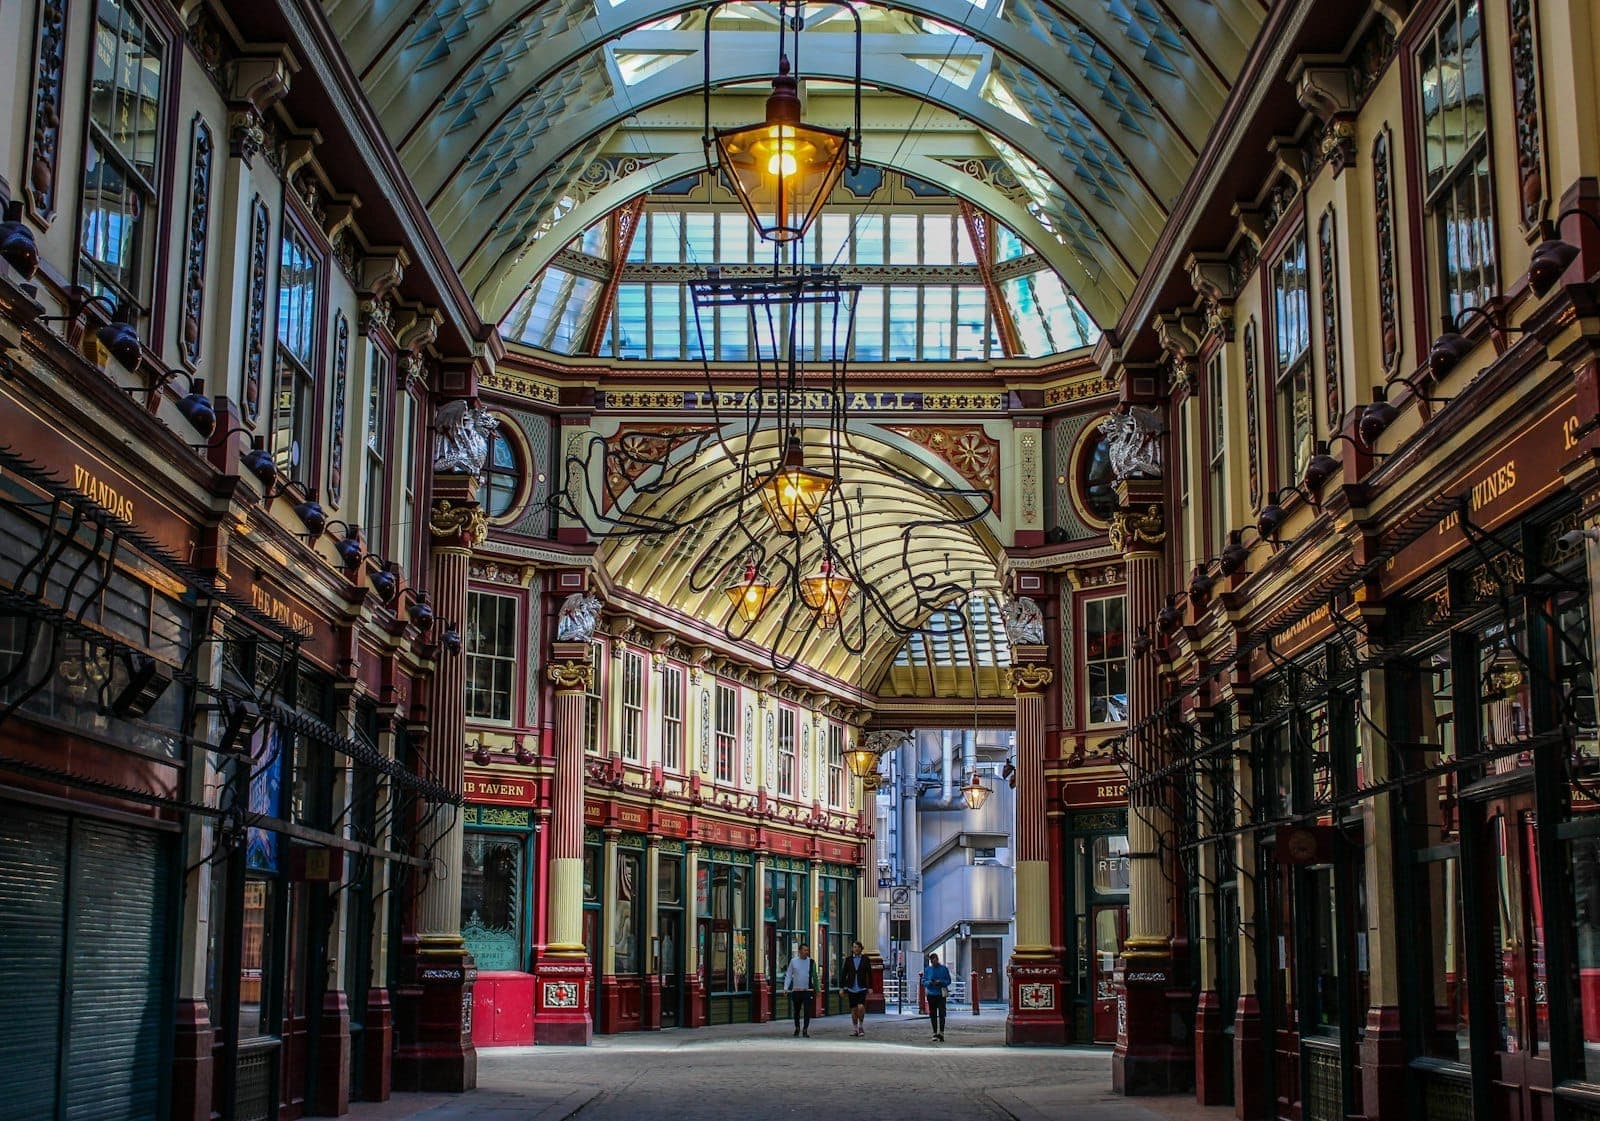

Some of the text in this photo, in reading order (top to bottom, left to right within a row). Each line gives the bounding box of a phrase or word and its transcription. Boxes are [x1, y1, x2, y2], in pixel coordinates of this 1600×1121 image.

[74, 463, 133, 525] VIANDAS
[1472, 460, 1516, 512] WINES
[251, 583, 271, 617] THE
[479, 783, 524, 796] TAVERN
